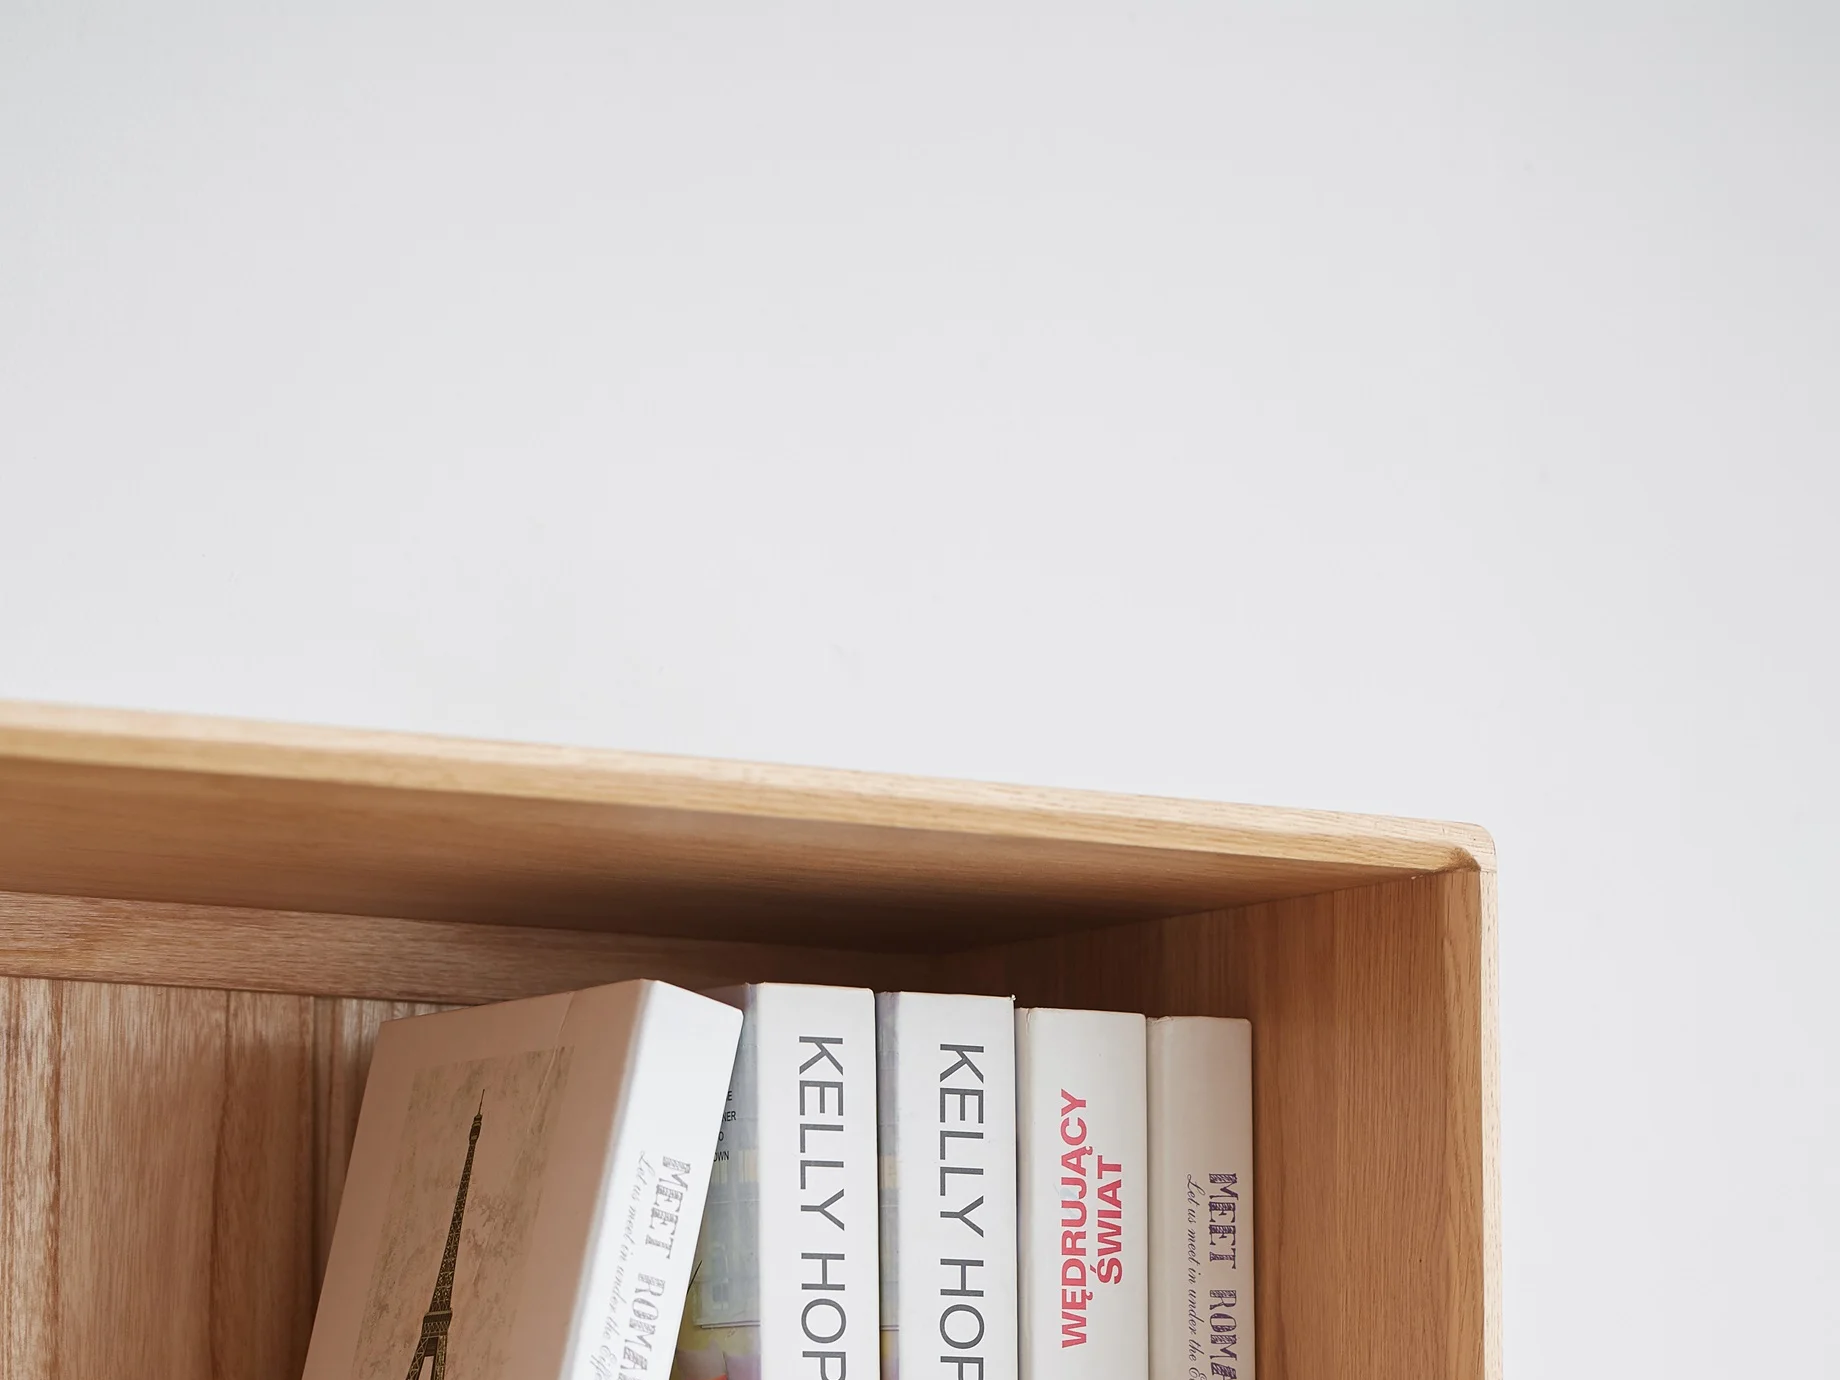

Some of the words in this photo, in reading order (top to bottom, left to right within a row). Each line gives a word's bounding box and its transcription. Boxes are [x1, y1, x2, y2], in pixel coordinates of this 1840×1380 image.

[799, 1035, 845, 1232] KELLY
[939, 1043, 985, 1238] KELLY
[635, 1150, 656, 1186] Let
[631, 1185, 642, 1202] us
[645, 1155, 691, 1260] MEET
[1186, 1173, 1206, 1206] Let
[623, 1205, 637, 1245] meet
[1060, 1088, 1094, 1349] WĘDRUJĄCY
[1090, 1154, 1123, 1285] ŚWIAT
[1187, 1208, 1197, 1224] us
[1208, 1173, 1239, 1270] MEET
[619, 1244, 635, 1261] in
[1187, 1228, 1201, 1266] meet
[608, 1265, 628, 1314] under
[1187, 1267, 1202, 1285] in
[602, 1316, 621, 1340] the
[1188, 1289, 1205, 1336] under
[1188, 1338, 1205, 1362] the
